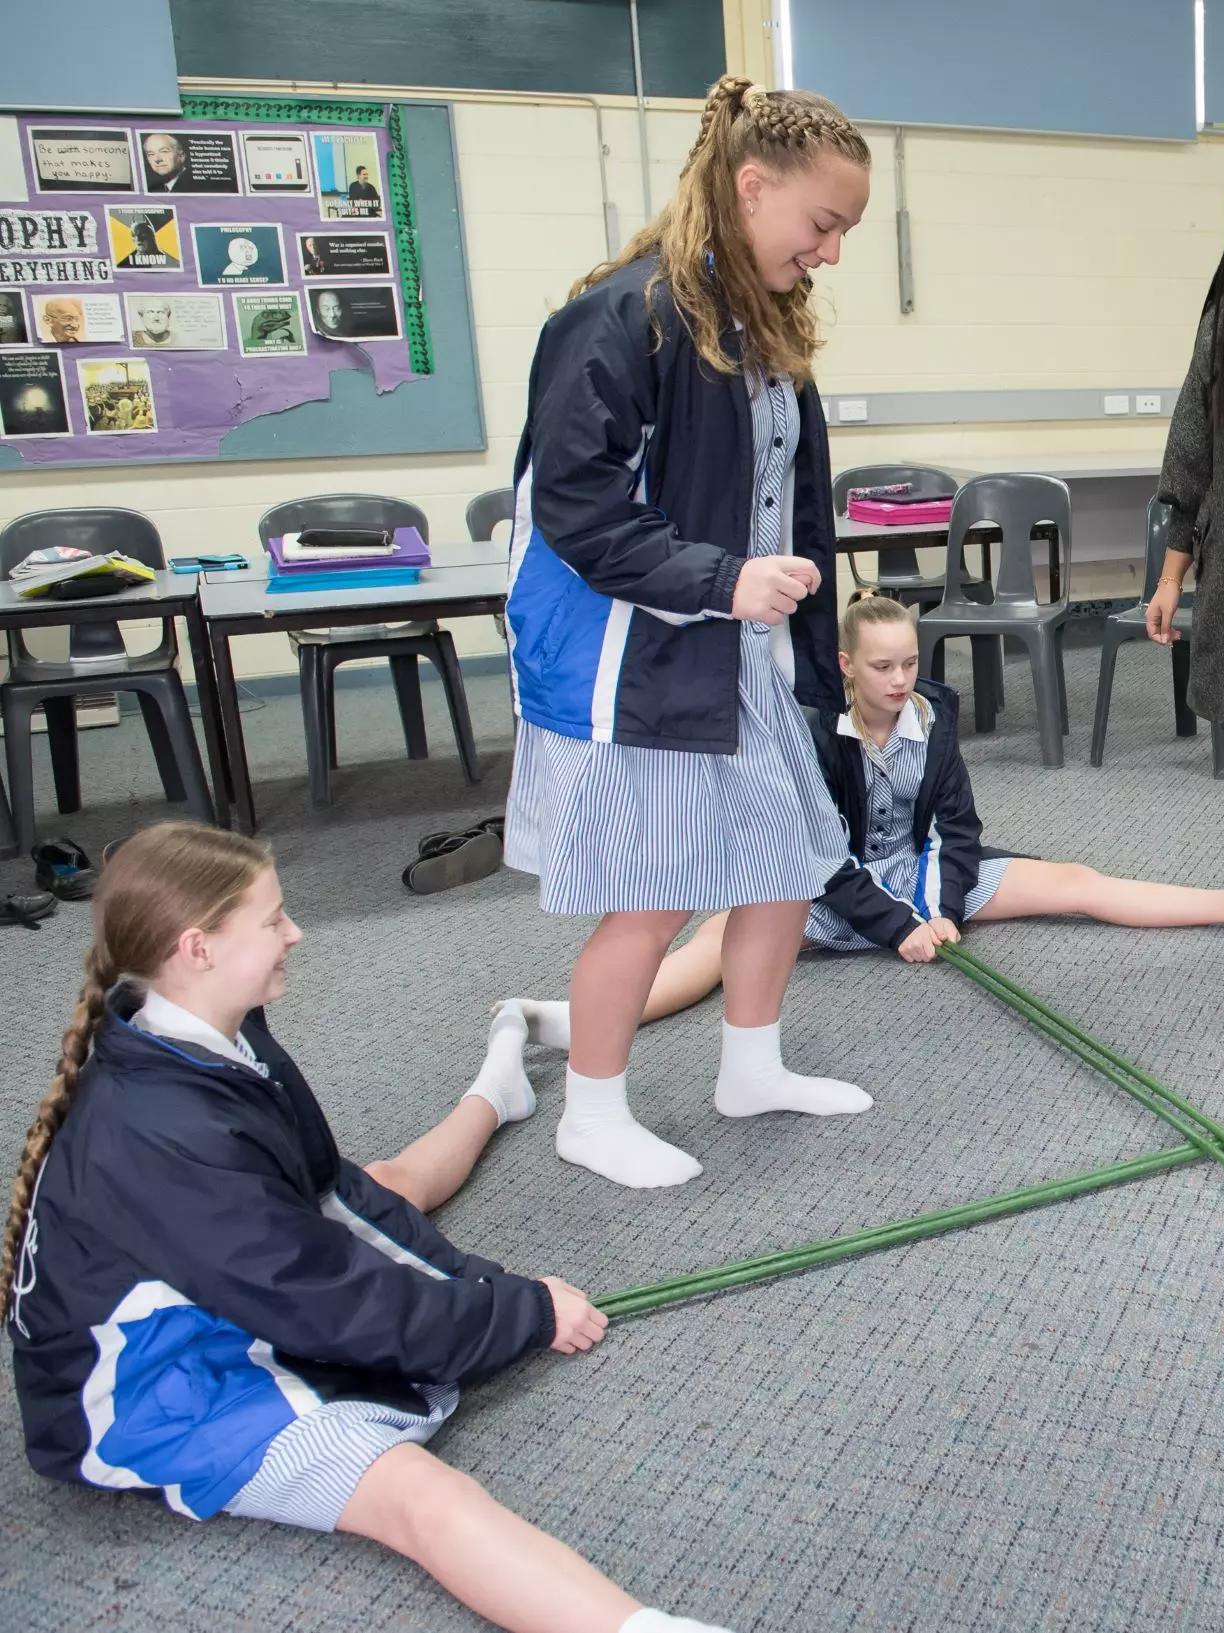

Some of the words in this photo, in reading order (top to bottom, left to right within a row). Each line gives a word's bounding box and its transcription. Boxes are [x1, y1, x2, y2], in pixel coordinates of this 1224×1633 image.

[38, 143, 53, 154] Be
[82, 146, 128, 156] someone
[41, 159, 64, 169] that
[71, 160, 111, 169] makes
[52, 170, 71, 180] you
[135, 254, 167, 265] KNOW
[0, 261, 108, 282] ERYTHING
